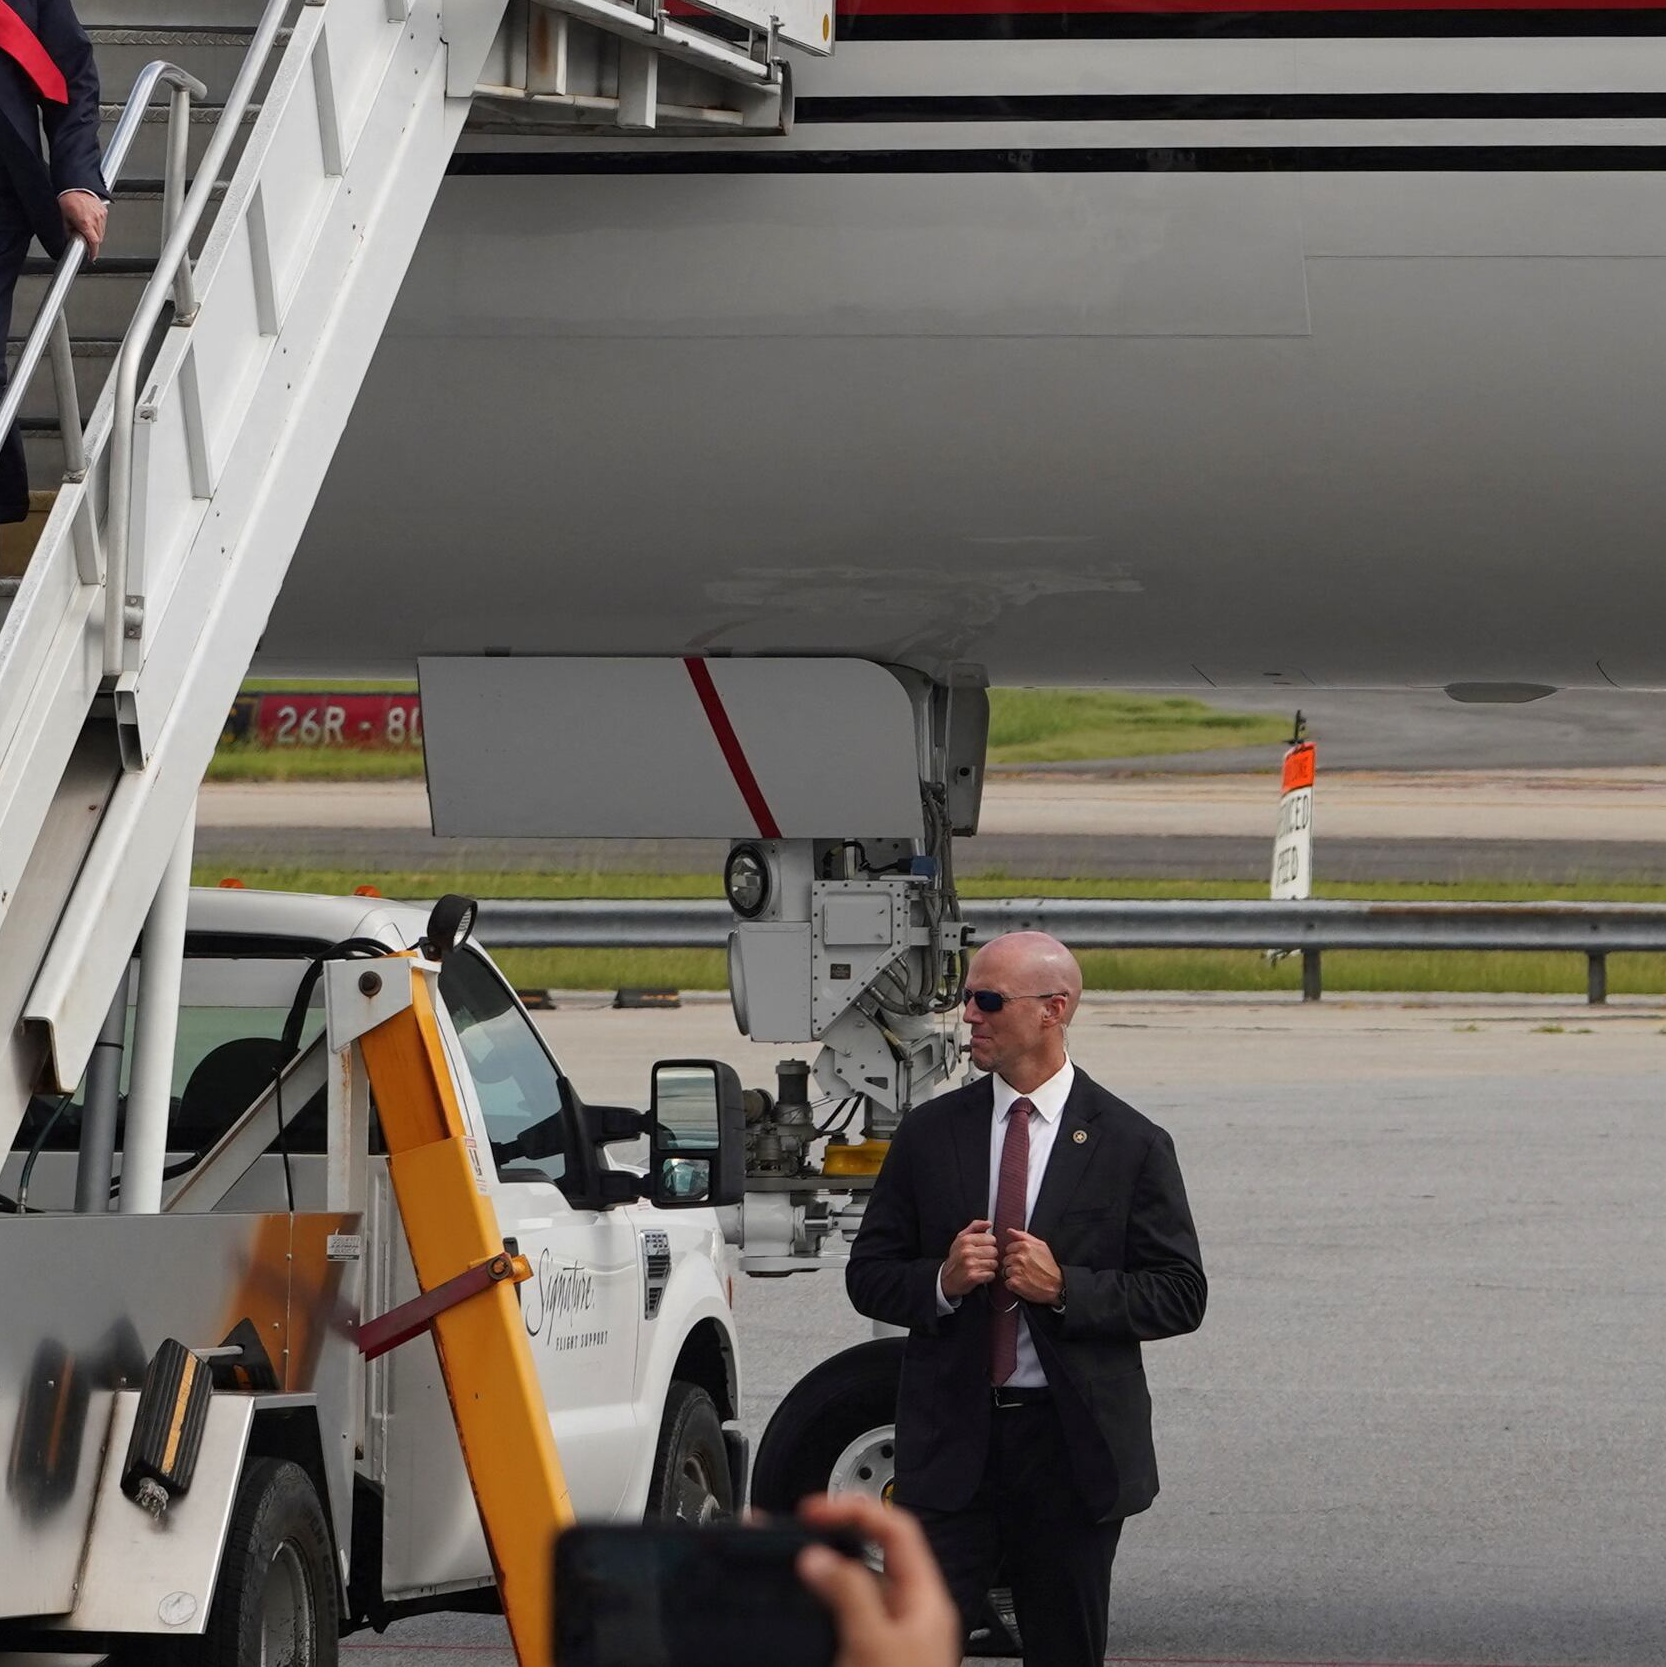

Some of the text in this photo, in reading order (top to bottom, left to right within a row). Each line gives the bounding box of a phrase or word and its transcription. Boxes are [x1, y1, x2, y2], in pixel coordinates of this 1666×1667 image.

[277, 706, 346, 744] 26R
[525, 1247, 595, 1345] Signature
[556, 1330, 608, 1351] FLIGHT SUPPORT
